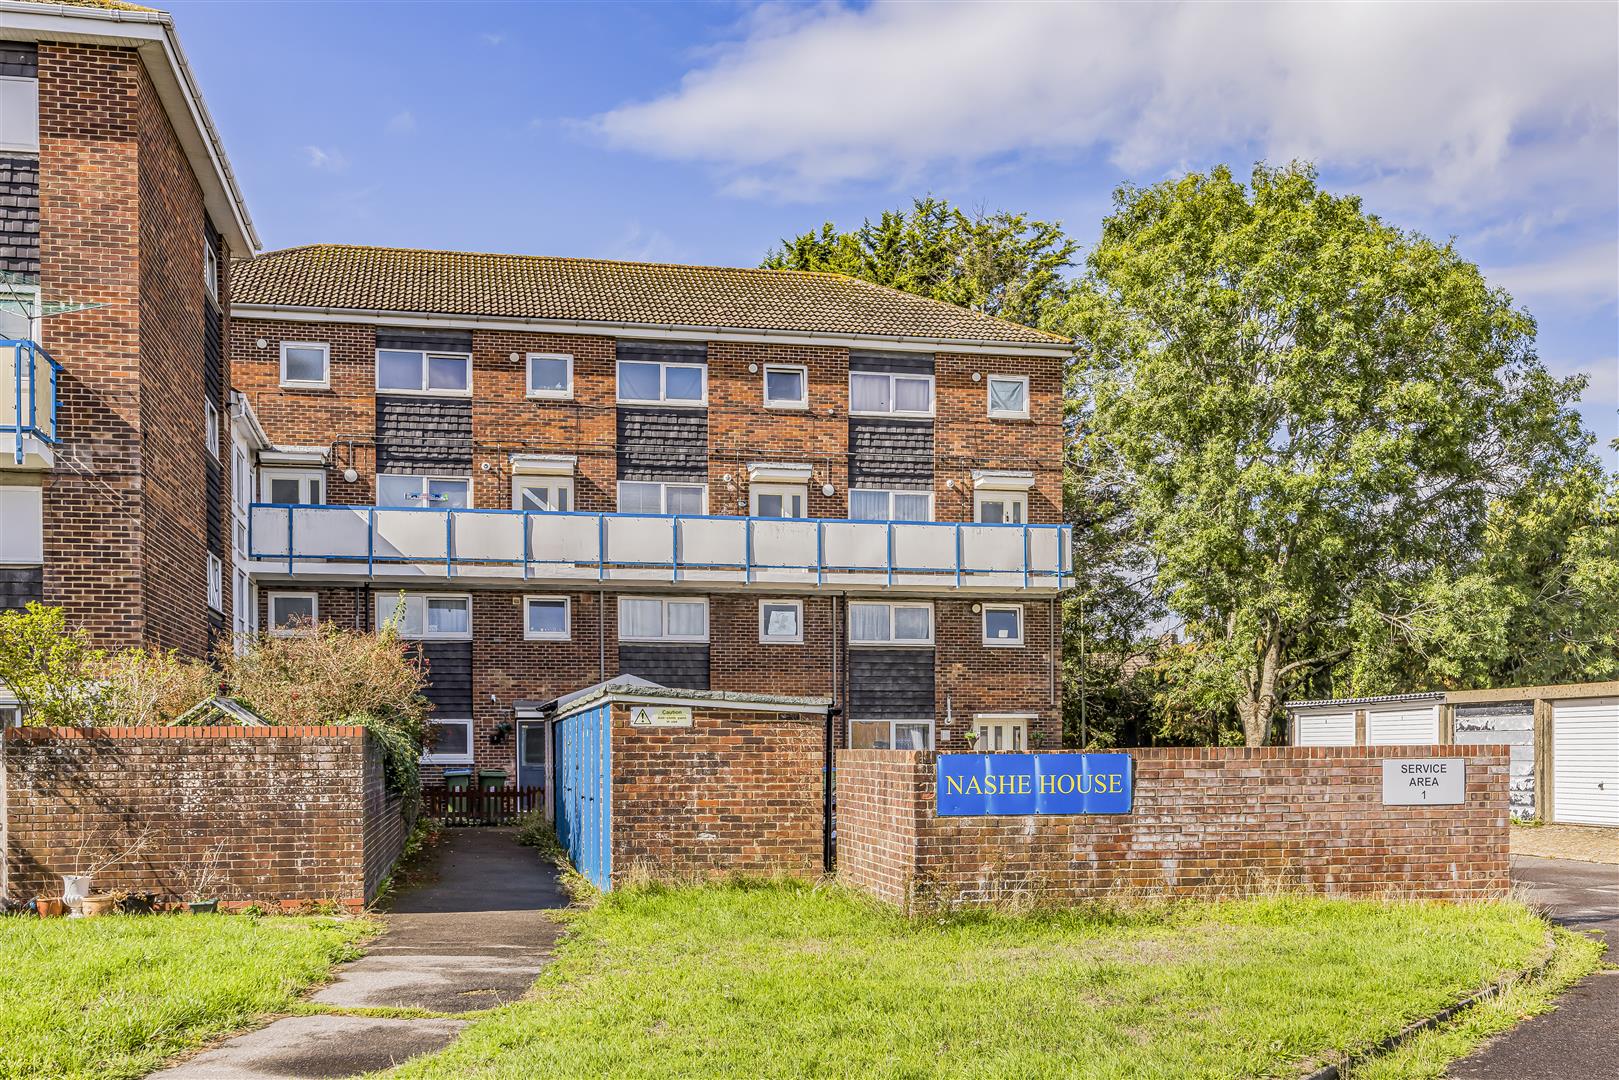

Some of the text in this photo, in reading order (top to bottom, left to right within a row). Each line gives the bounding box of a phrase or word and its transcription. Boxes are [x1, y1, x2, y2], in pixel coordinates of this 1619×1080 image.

[1401, 764, 1447, 773] SERVICE
[946, 774, 1123, 795] NASHE HOUSE
[1409, 777, 1439, 786] AREA
[1421, 790, 1426, 799] 1
